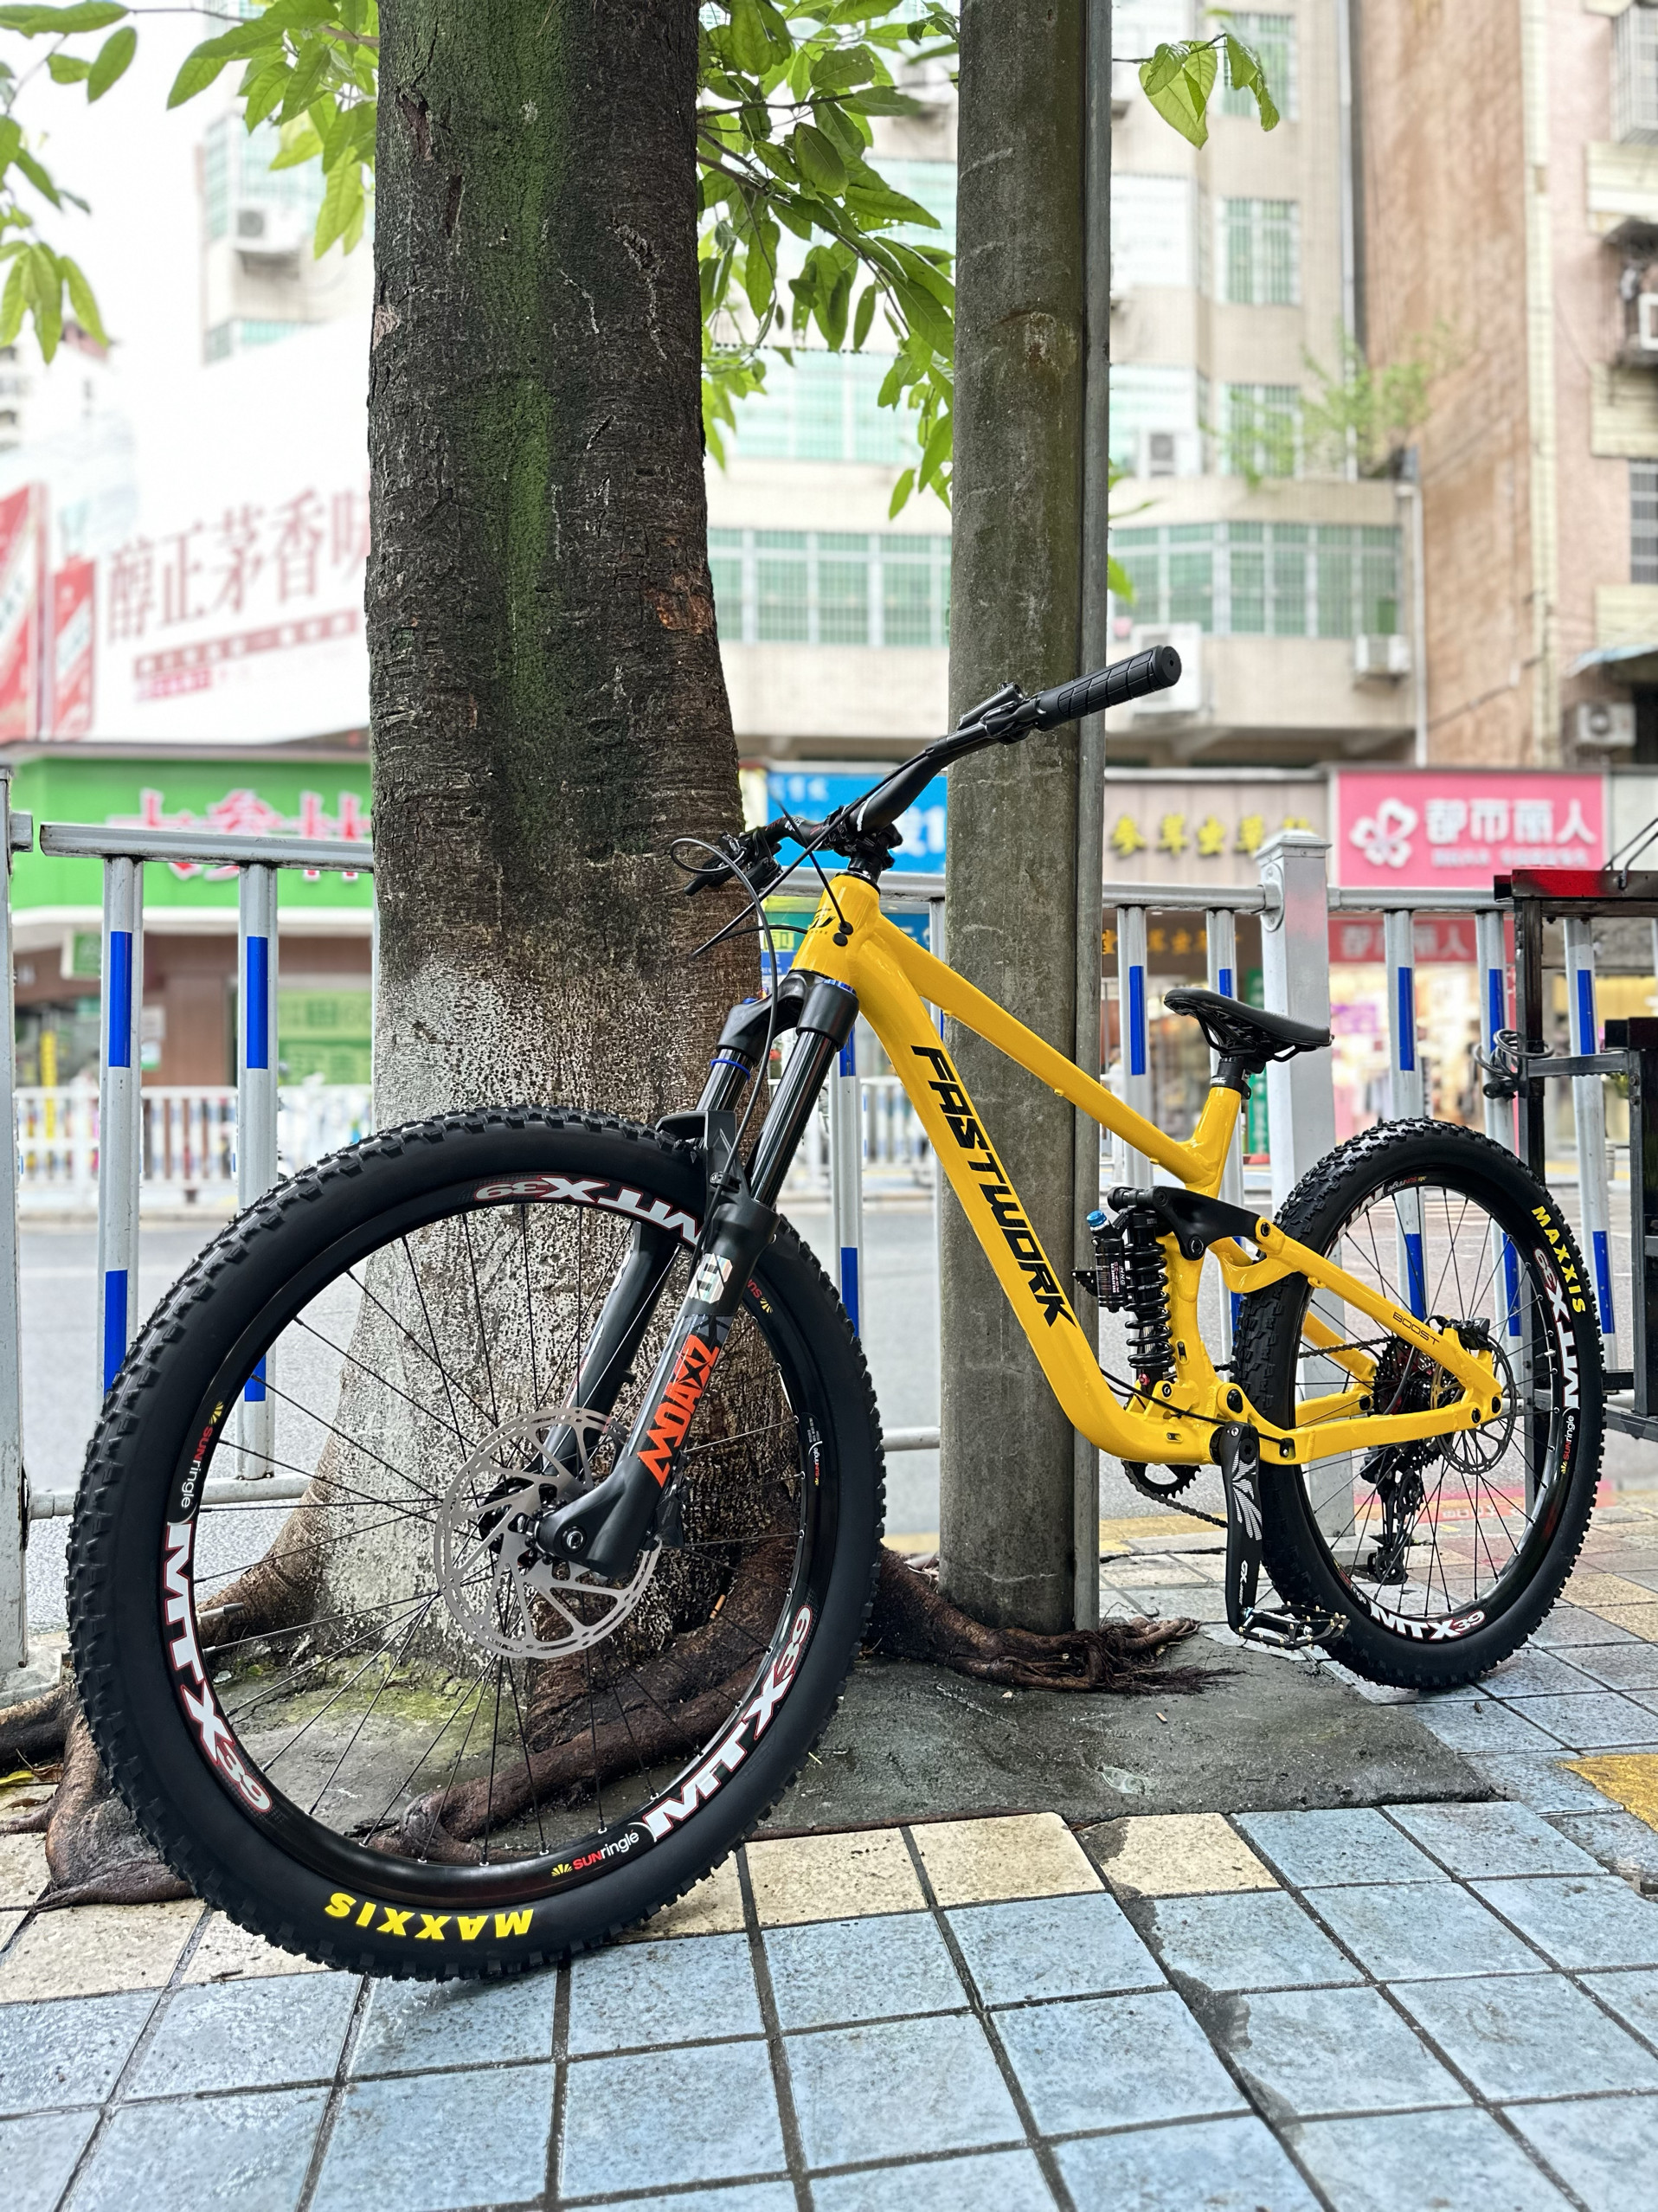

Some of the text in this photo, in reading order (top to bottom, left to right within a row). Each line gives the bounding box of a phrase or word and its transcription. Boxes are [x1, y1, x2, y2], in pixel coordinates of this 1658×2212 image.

[1424, 797, 1597, 845] 都市丽人
[910, 1045, 1078, 1328] FASTWORK
[1531, 1206, 1586, 1313] MAXXIS
[1392, 1311, 1440, 1345] BOOST
[1533, 1246, 1580, 1409] MTX39
[164, 1521, 273, 1814] MTX39
[1368, 1600, 1486, 1641] MTX39
[642, 1605, 813, 1841] MTX39
[325, 1892, 534, 1940] MAXXIS
